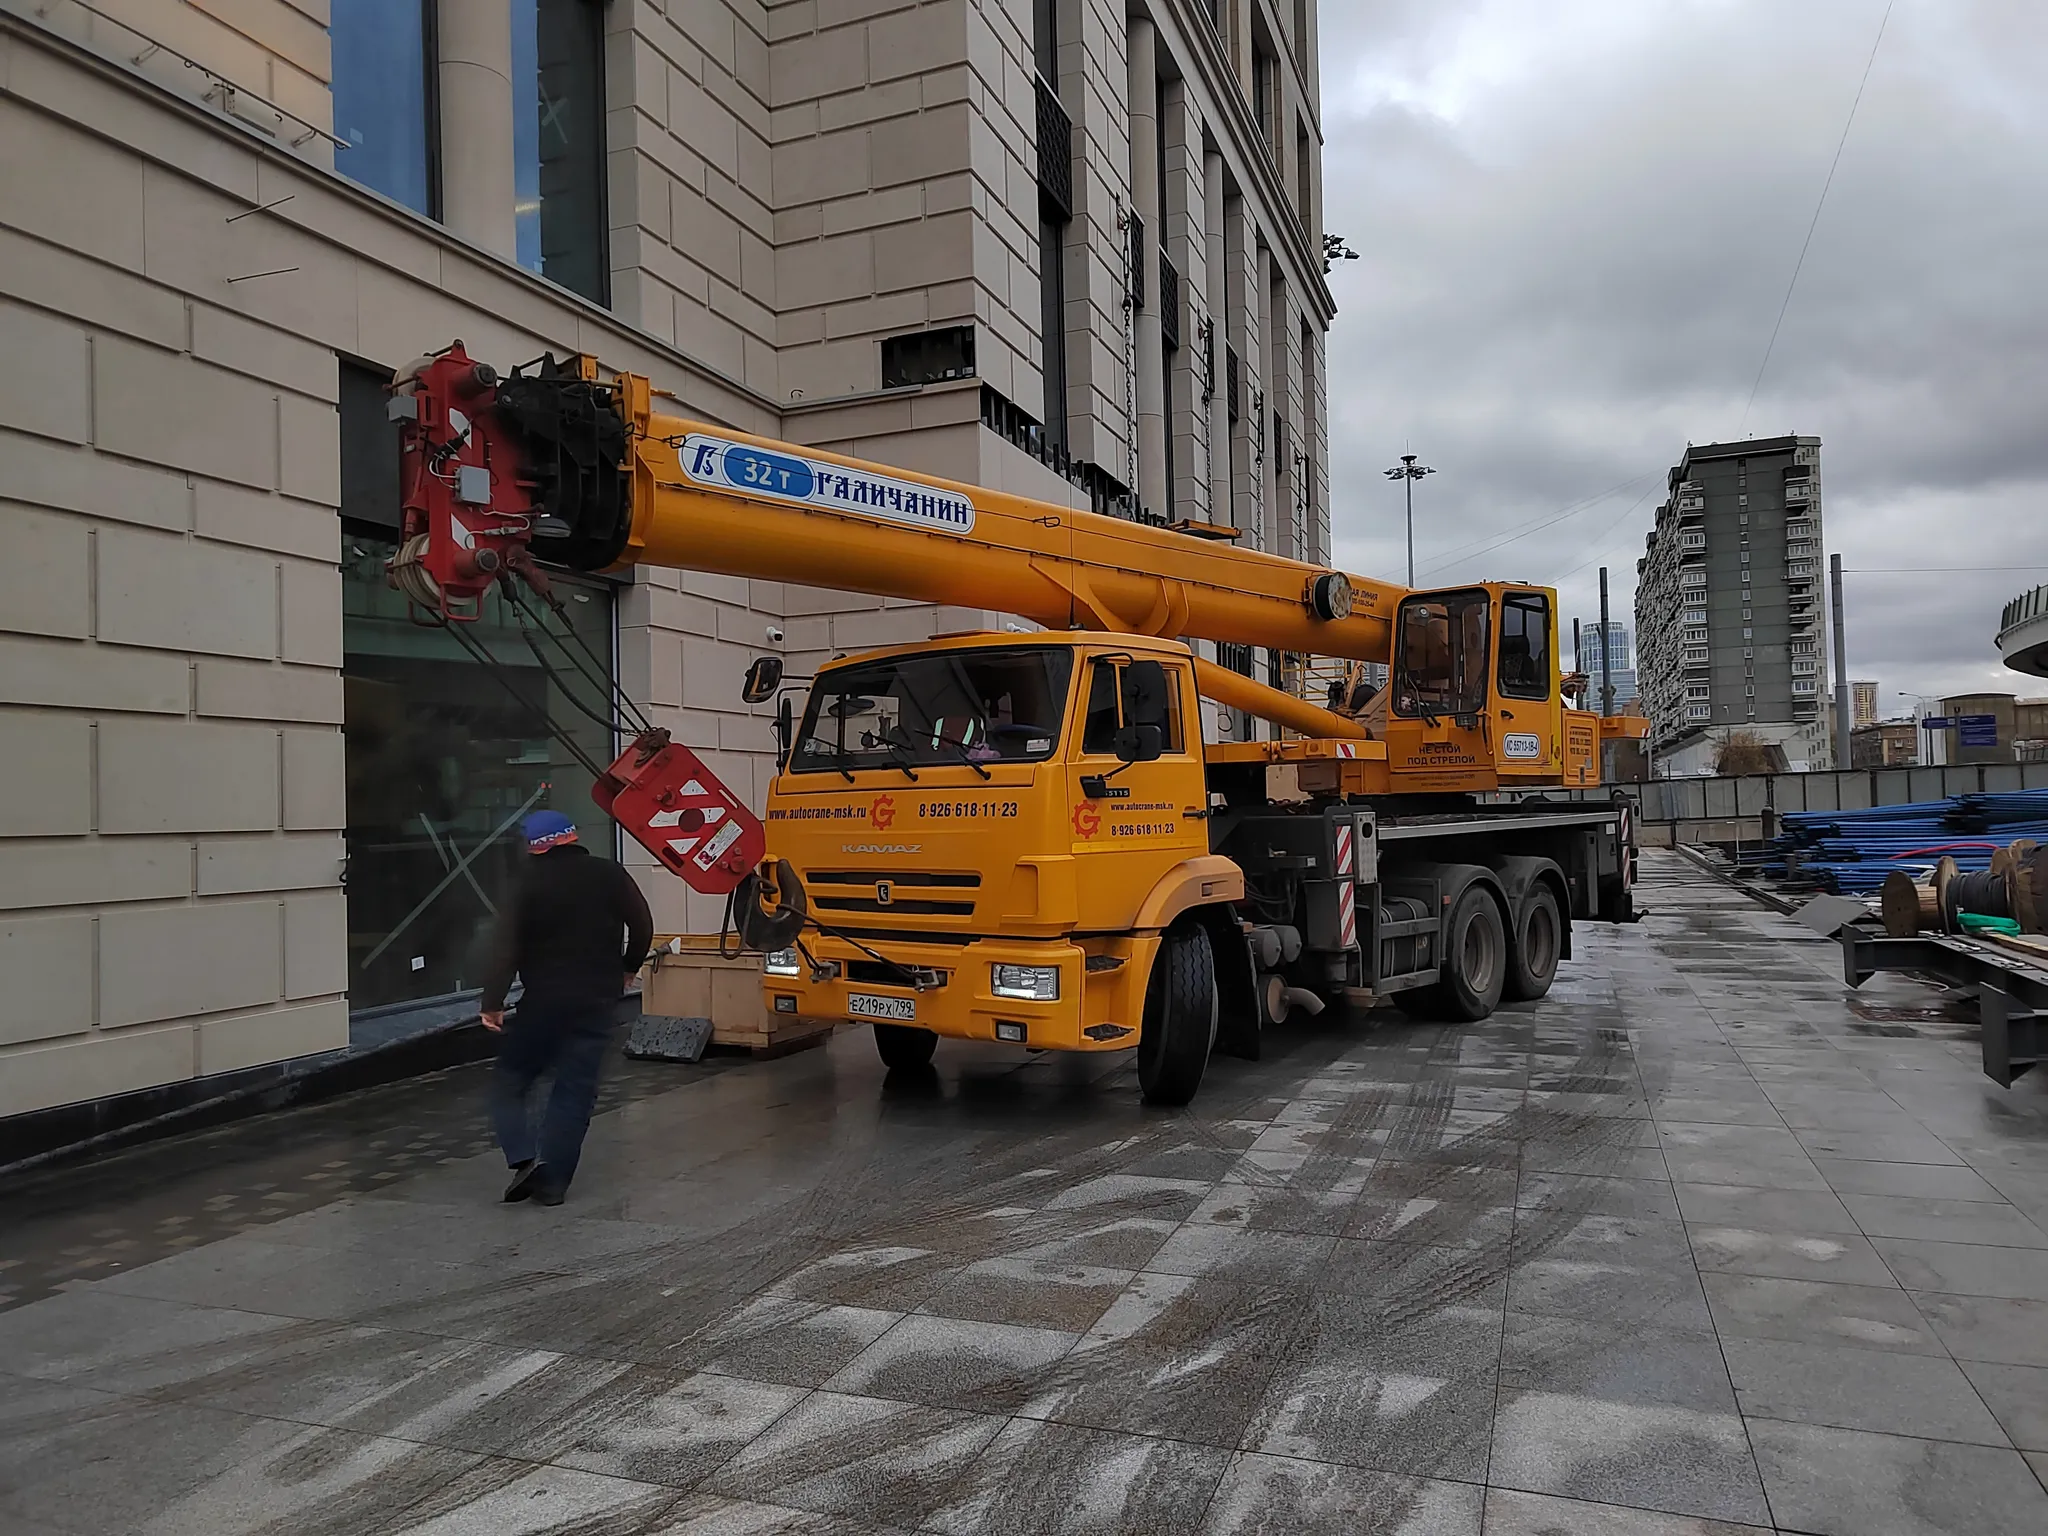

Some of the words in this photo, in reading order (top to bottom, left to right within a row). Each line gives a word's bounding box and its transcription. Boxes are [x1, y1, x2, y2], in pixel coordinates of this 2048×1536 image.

[744, 456, 772, 487] 32
[816, 470, 968, 525] ГАЛИЧАНИН
[1418, 746, 1432, 755] НЕ
[1434, 744, 1461, 754] СТОЙ
[1407, 756, 1428, 766] ПОД
[1429, 754, 1476, 765] СТРЕЛОЙ
[768, 805, 866, 820] www.autocrane-msk.ru
[1110, 802, 1174, 811] www.autocrane-msk.ru
[842, 844, 922, 853] KAMAZ
[894, 1000, 912, 1014] 799
